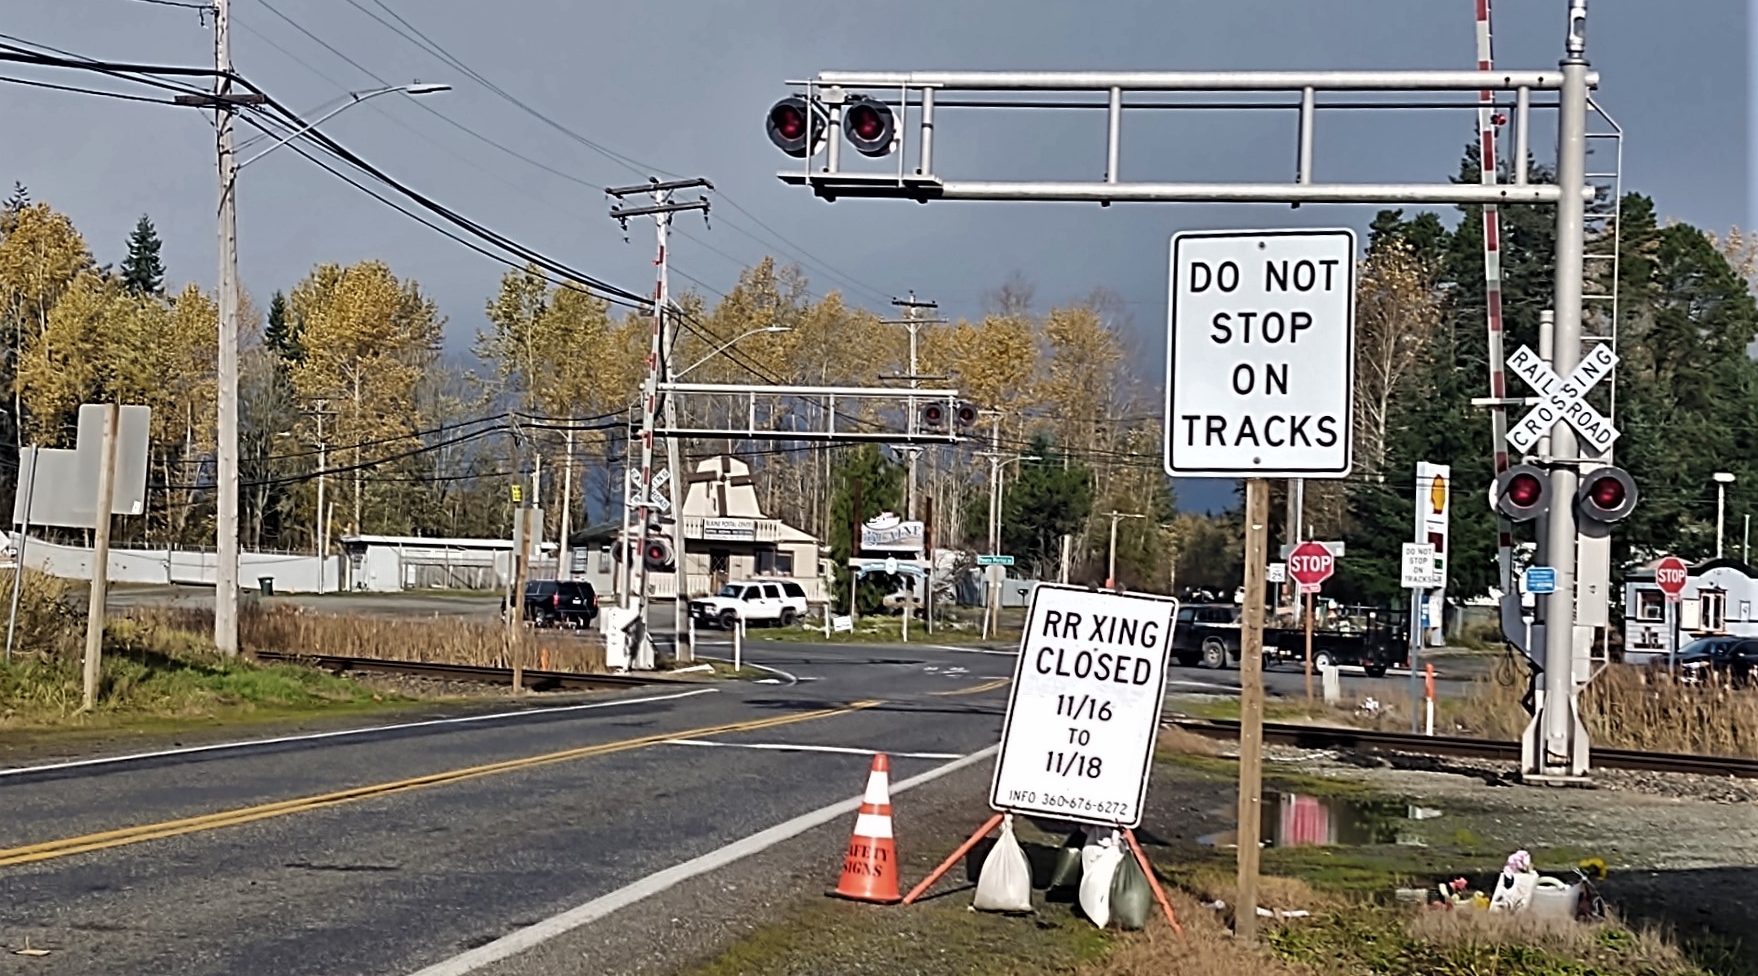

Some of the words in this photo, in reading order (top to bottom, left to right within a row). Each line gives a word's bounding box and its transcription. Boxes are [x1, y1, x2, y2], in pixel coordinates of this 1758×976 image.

[1190, 260, 1240, 293] DO
[1265, 259, 1340, 293] NOT
[1210, 311, 1313, 344] STOP
[1232, 363, 1288, 396] ON
[1513, 350, 1612, 446] CROSSING
[1181, 415, 1338, 448] TRACKS
[1291, 555, 1331, 573] STOP
[1658, 568, 1685, 583] STOP
[1042, 610, 1082, 640] RR
[1089, 614, 1159, 648] XING
[1036, 646, 1151, 685] CLOSED
[1057, 694, 1113, 721] 11/16
[1068, 727, 1090, 746] TO
[1046, 751, 1102, 778] 11/18
[1009, 790, 1036, 804] INFO
[1041, 793, 1129, 816] 360-676-6272
[849, 844, 889, 862] AFETY
